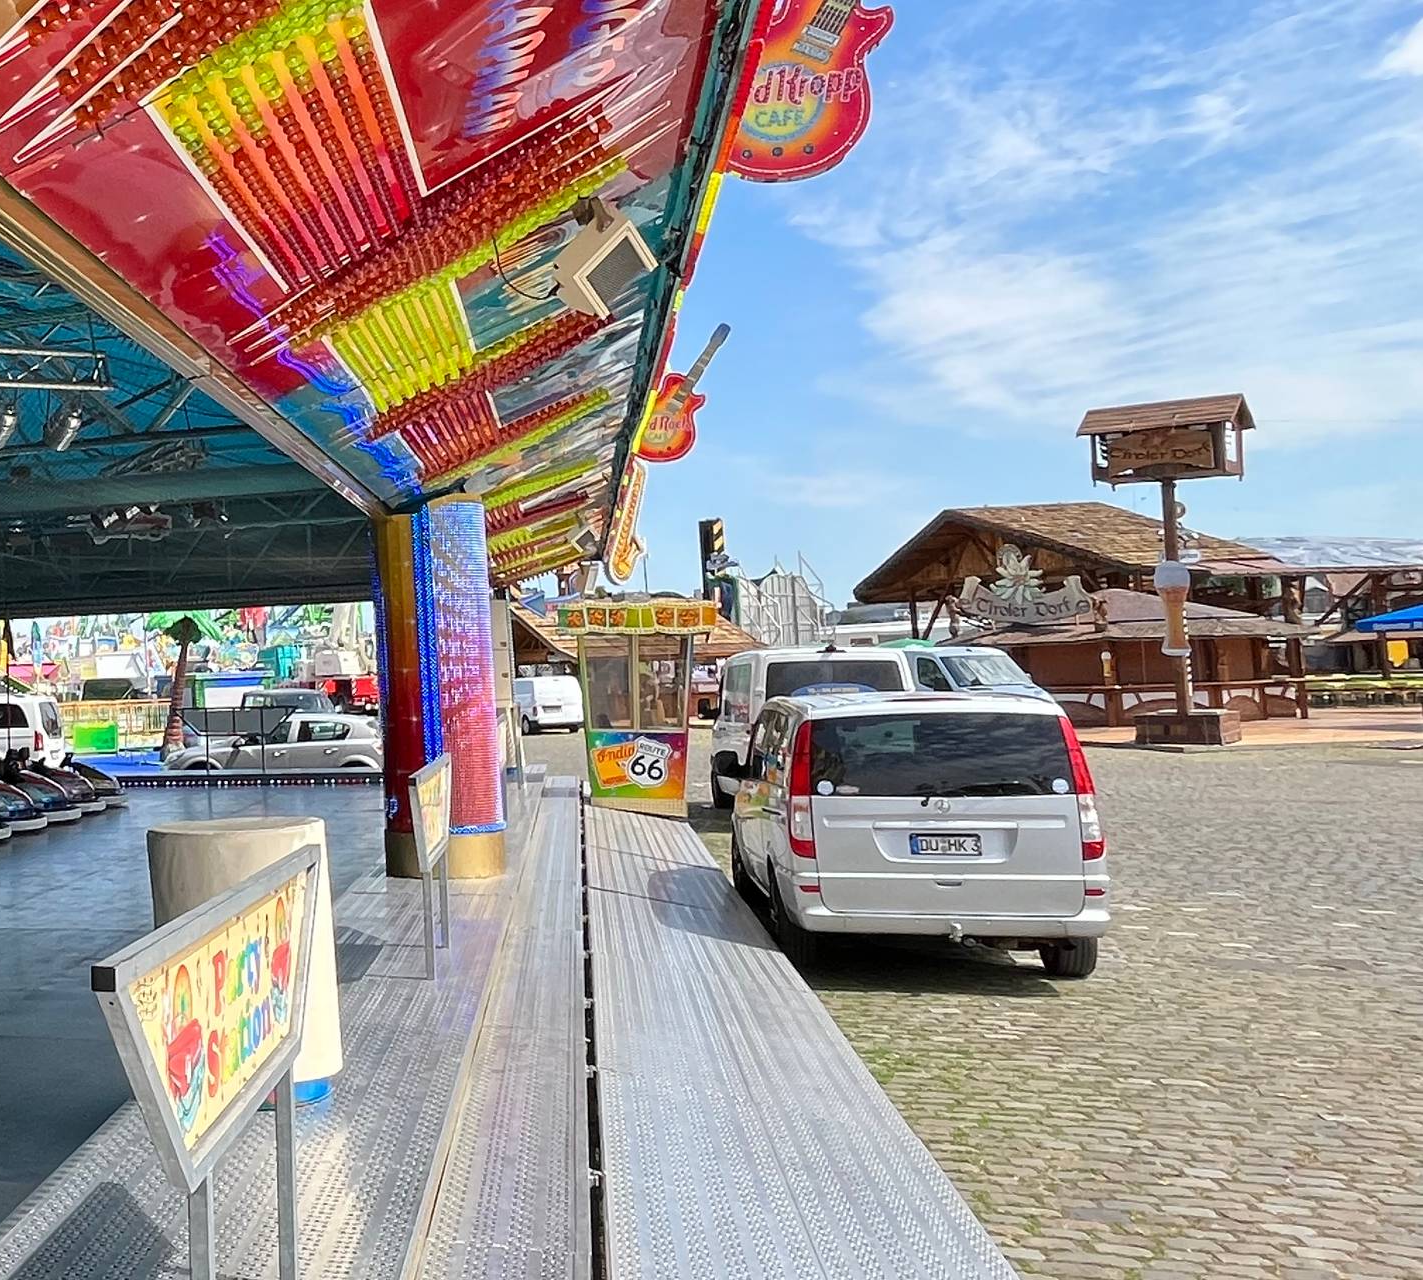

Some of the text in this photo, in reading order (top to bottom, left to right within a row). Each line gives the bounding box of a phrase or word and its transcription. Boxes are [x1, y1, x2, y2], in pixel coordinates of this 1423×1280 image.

[1033, 596, 1072, 617] Dorf
[639, 742, 667, 757] ROUTE
[630, 754, 664, 781] 66
[211, 934, 263, 1018] Party
[206, 994, 272, 1099] Station
